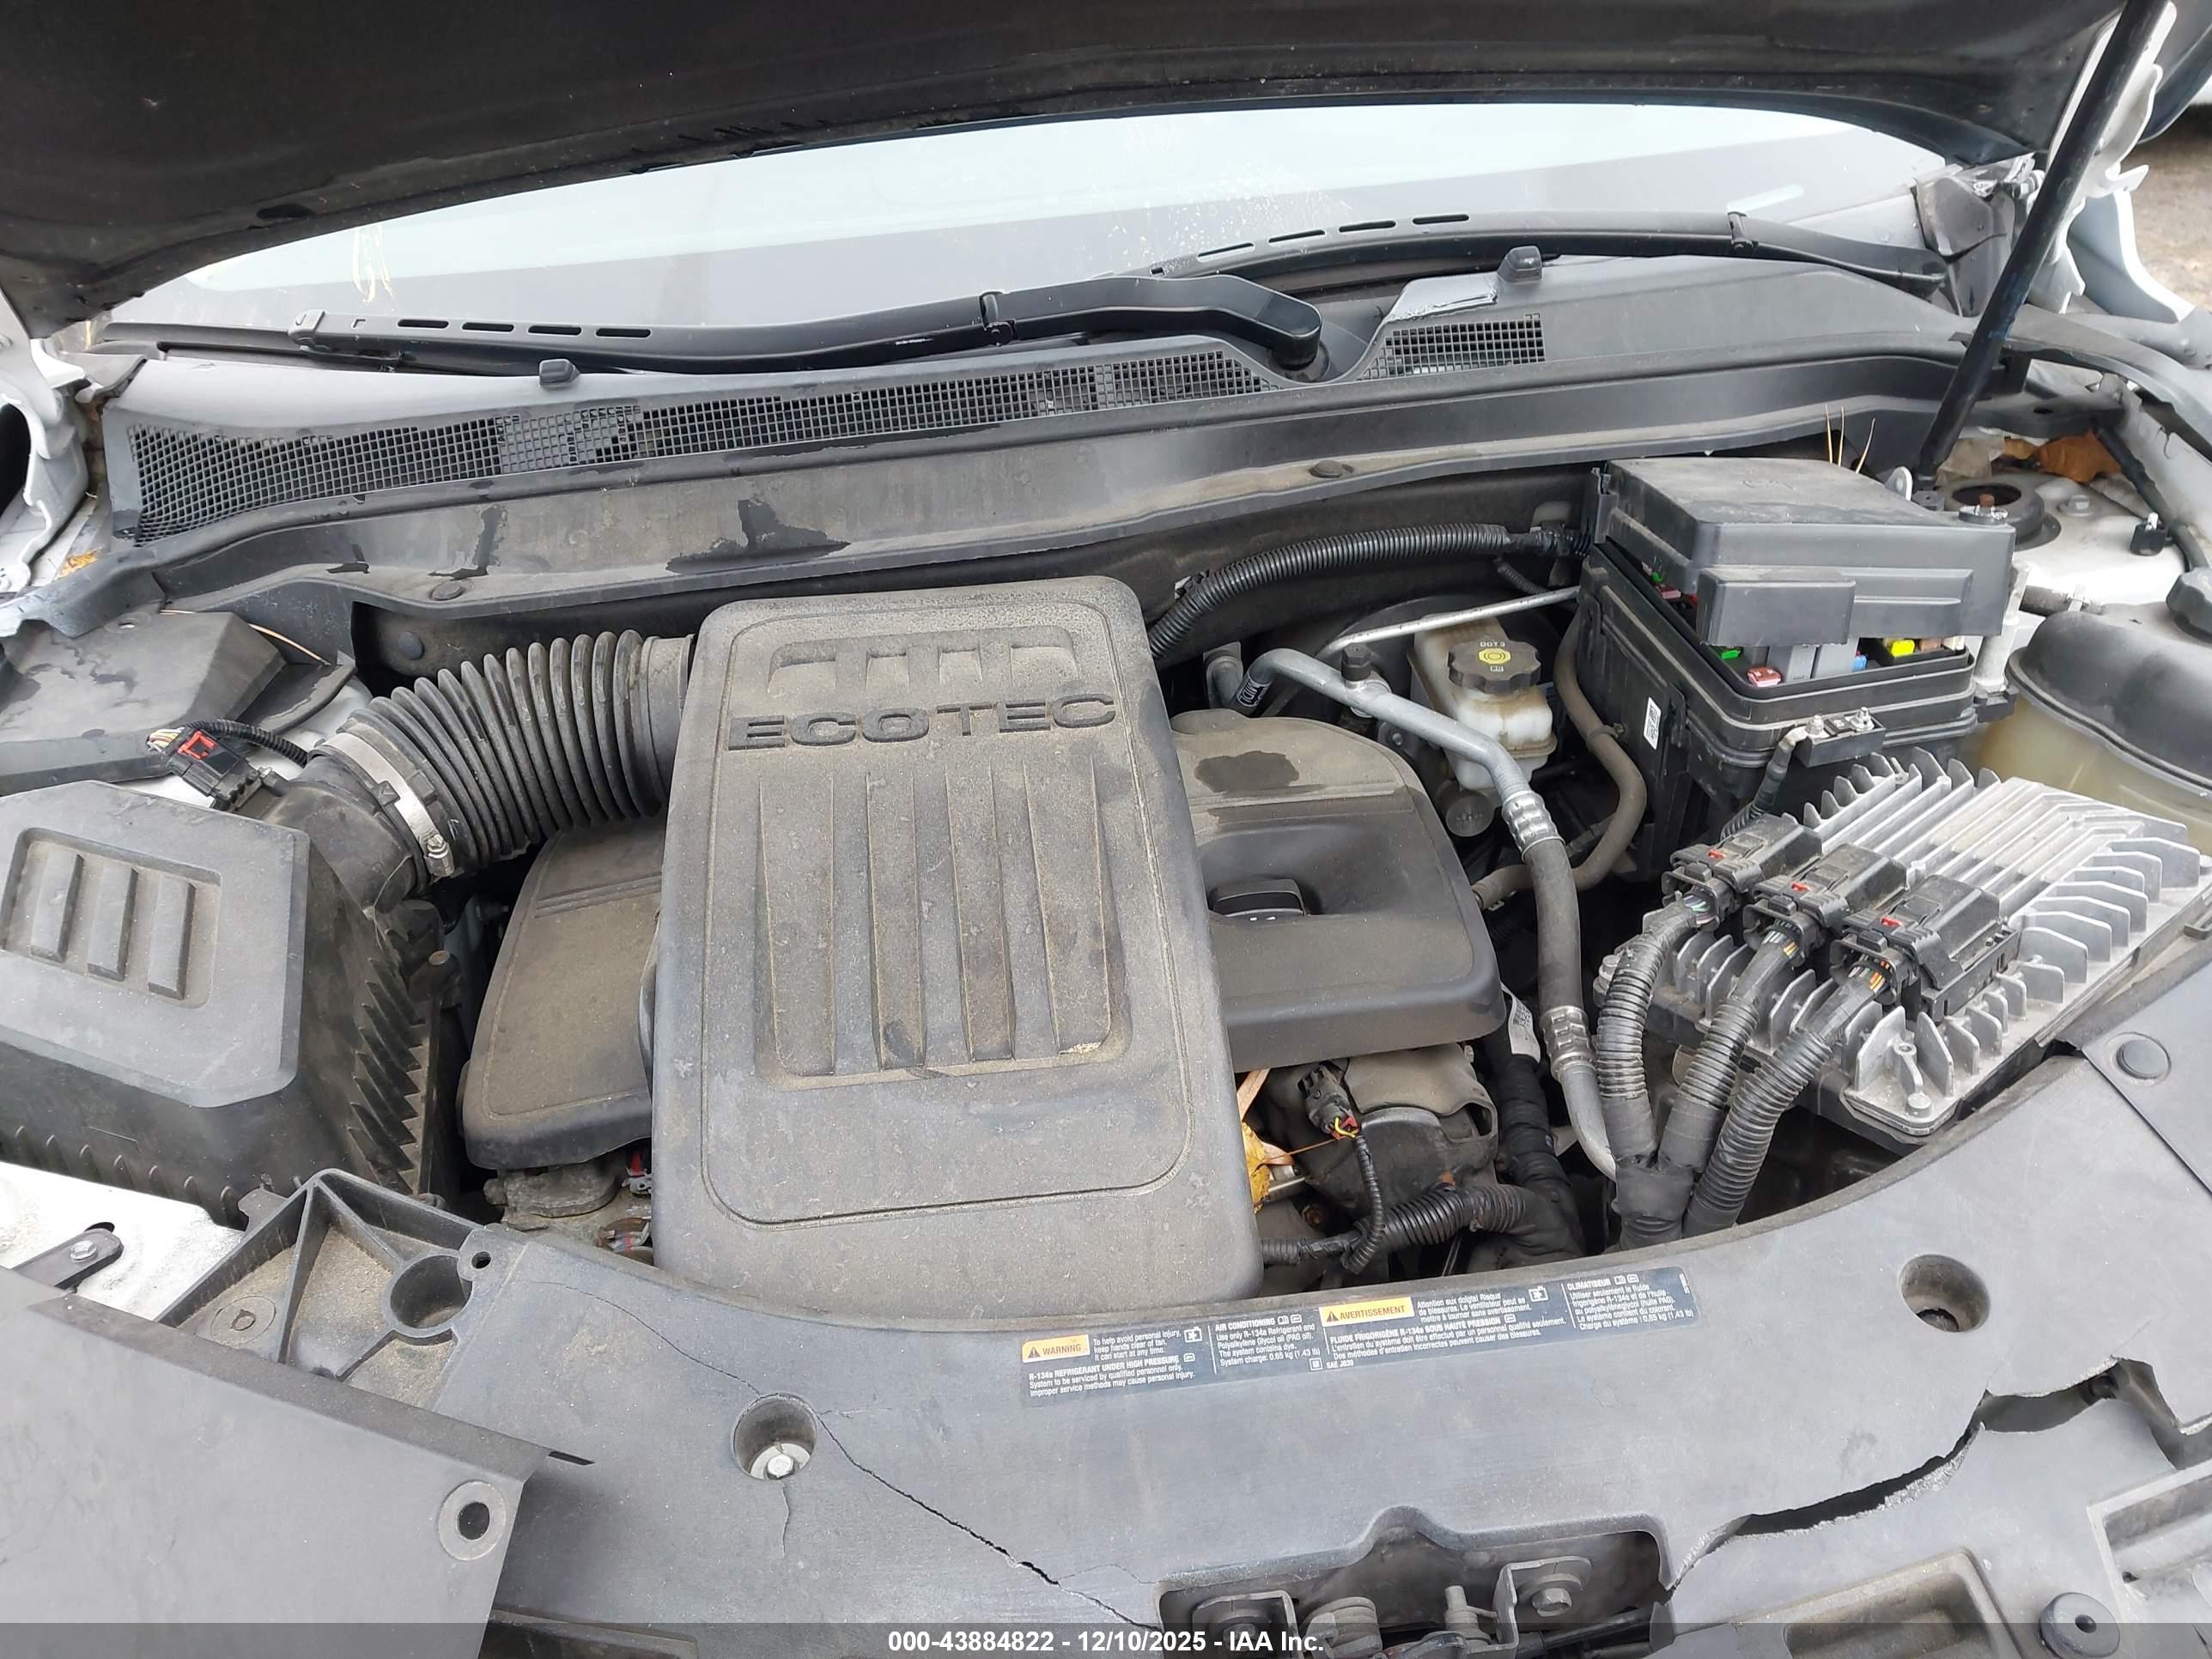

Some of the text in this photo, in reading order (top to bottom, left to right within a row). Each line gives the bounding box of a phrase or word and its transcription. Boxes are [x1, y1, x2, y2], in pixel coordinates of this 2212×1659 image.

[727, 693, 1115, 751] ECOTEC
[1567, 1279, 1612, 1290] CLIMATISEUR
[1340, 1305, 1405, 1320] AVERTISSEMENT
[1429, 1305, 1459, 1315] blessures.
[1470, 1300, 1501, 1310] ventilateur
[1503, 1298, 1517, 1307] peut
[1228, 1318, 1275, 1330] CONDITIONING
[1268, 1325, 1302, 1336] Refrigerant
[1330, 1334, 1354, 1344] FLUIDE
[1400, 1327, 1424, 1335] R-134a
[1425, 1324, 1444, 1333] SOUS
[1468, 1317, 1501, 1328] PRESSION
[1103, 1337, 1115, 1346] help
[1135, 1332, 1161, 1342] personal
[1163, 1329, 1182, 1339] injury,
[1218, 1339, 1255, 1350] Polyalkylene
[1257, 1337, 1276, 1346] Glycol
[1043, 1344, 1081, 1356] WARNING
[1220, 1358, 1244, 1367] System
[1244, 1354, 1268, 1364] charge:
[1285, 1352, 1293, 1360] kg
[1294, 1349, 1311, 1358] (1.43
[1232, 1348, 1255, 1357] system
[1256, 1345, 1282, 1353] contains
[1029, 1371, 1054, 1380] R-134a
[1054, 1365, 1101, 1376] REFRIGERANT
[1102, 1362, 1126, 1370] UNDER
[1145, 1356, 1179, 1366] PRESSURE
[1030, 1379, 1053, 1389] System
[1072, 1374, 1098, 1383] serviced
[1109, 1370, 1135, 1379] qualified
[1136, 1366, 1167, 1376] personnel
[1169, 1364, 1182, 1372] only.
[1030, 1388, 1060, 1397] Improper
[1084, 1382, 1111, 1390] methods
[1148, 1374, 1175, 1383] personal
[1176, 1371, 1195, 1380] injury.
